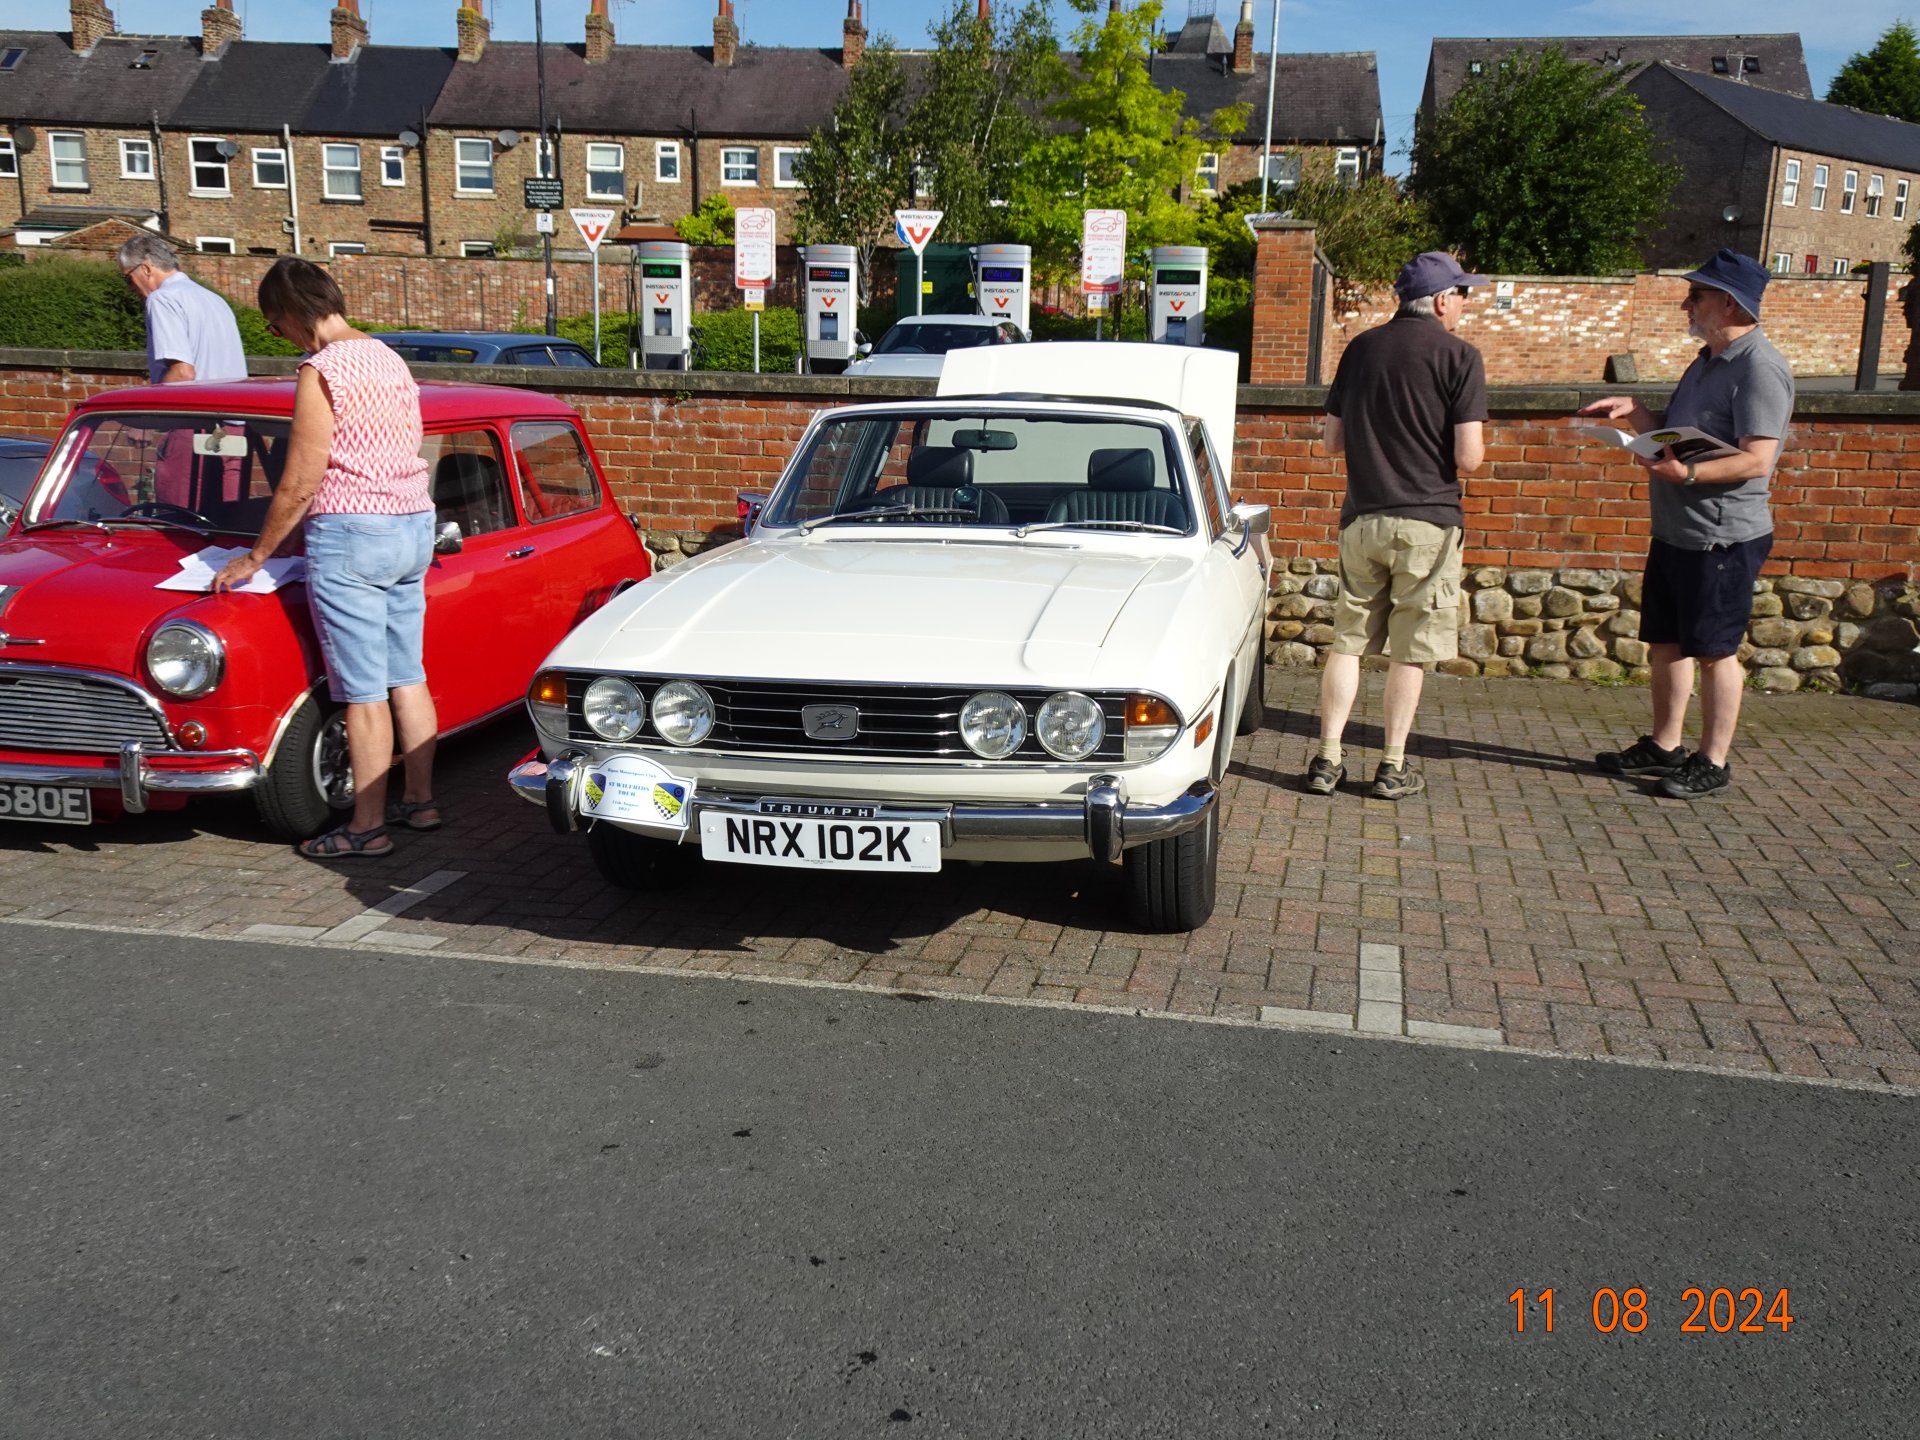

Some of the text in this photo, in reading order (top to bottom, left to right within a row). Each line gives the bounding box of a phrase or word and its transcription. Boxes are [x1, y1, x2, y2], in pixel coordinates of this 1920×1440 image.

[766, 803, 868, 818] TRIUMPH
[726, 817, 912, 863] NRX 102K
